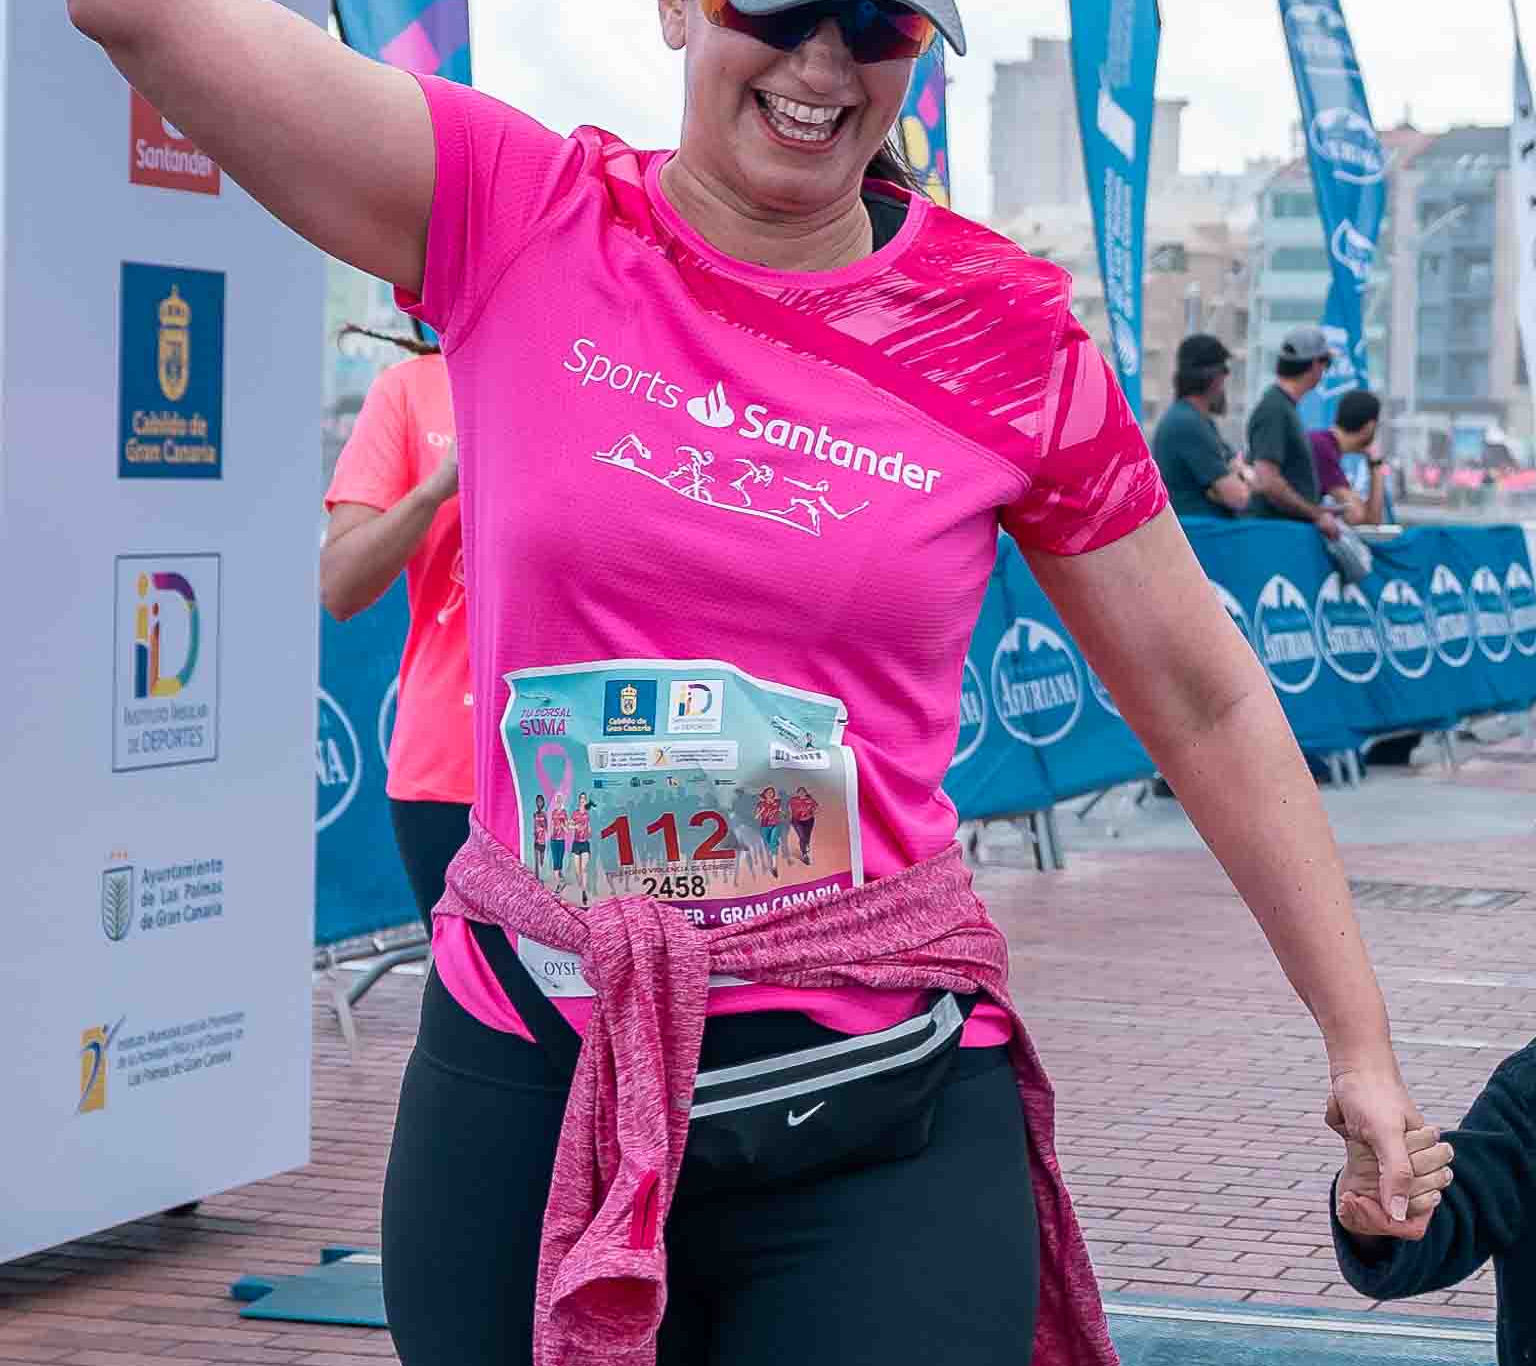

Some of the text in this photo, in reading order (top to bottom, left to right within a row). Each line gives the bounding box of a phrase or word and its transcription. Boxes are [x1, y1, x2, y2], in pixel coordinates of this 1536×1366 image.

[132, 410, 209, 436] Cabildo de
[564, 338, 944, 495] Sports Santander
[126, 438, 217, 464] Gran Canaria
[999, 668, 1078, 720] ASTURIANA
[141, 725, 204, 754] DEPORTES
[519, 718, 568, 736] SUMA
[600, 810, 737, 866] 112
[140, 858, 224, 885] Ayuntamiento
[140, 877, 224, 907] de Las Palmas
[641, 874, 707, 899] 2458
[139, 902, 223, 931] de Gran Canaria
[720, 905, 769, 925] GRAN
